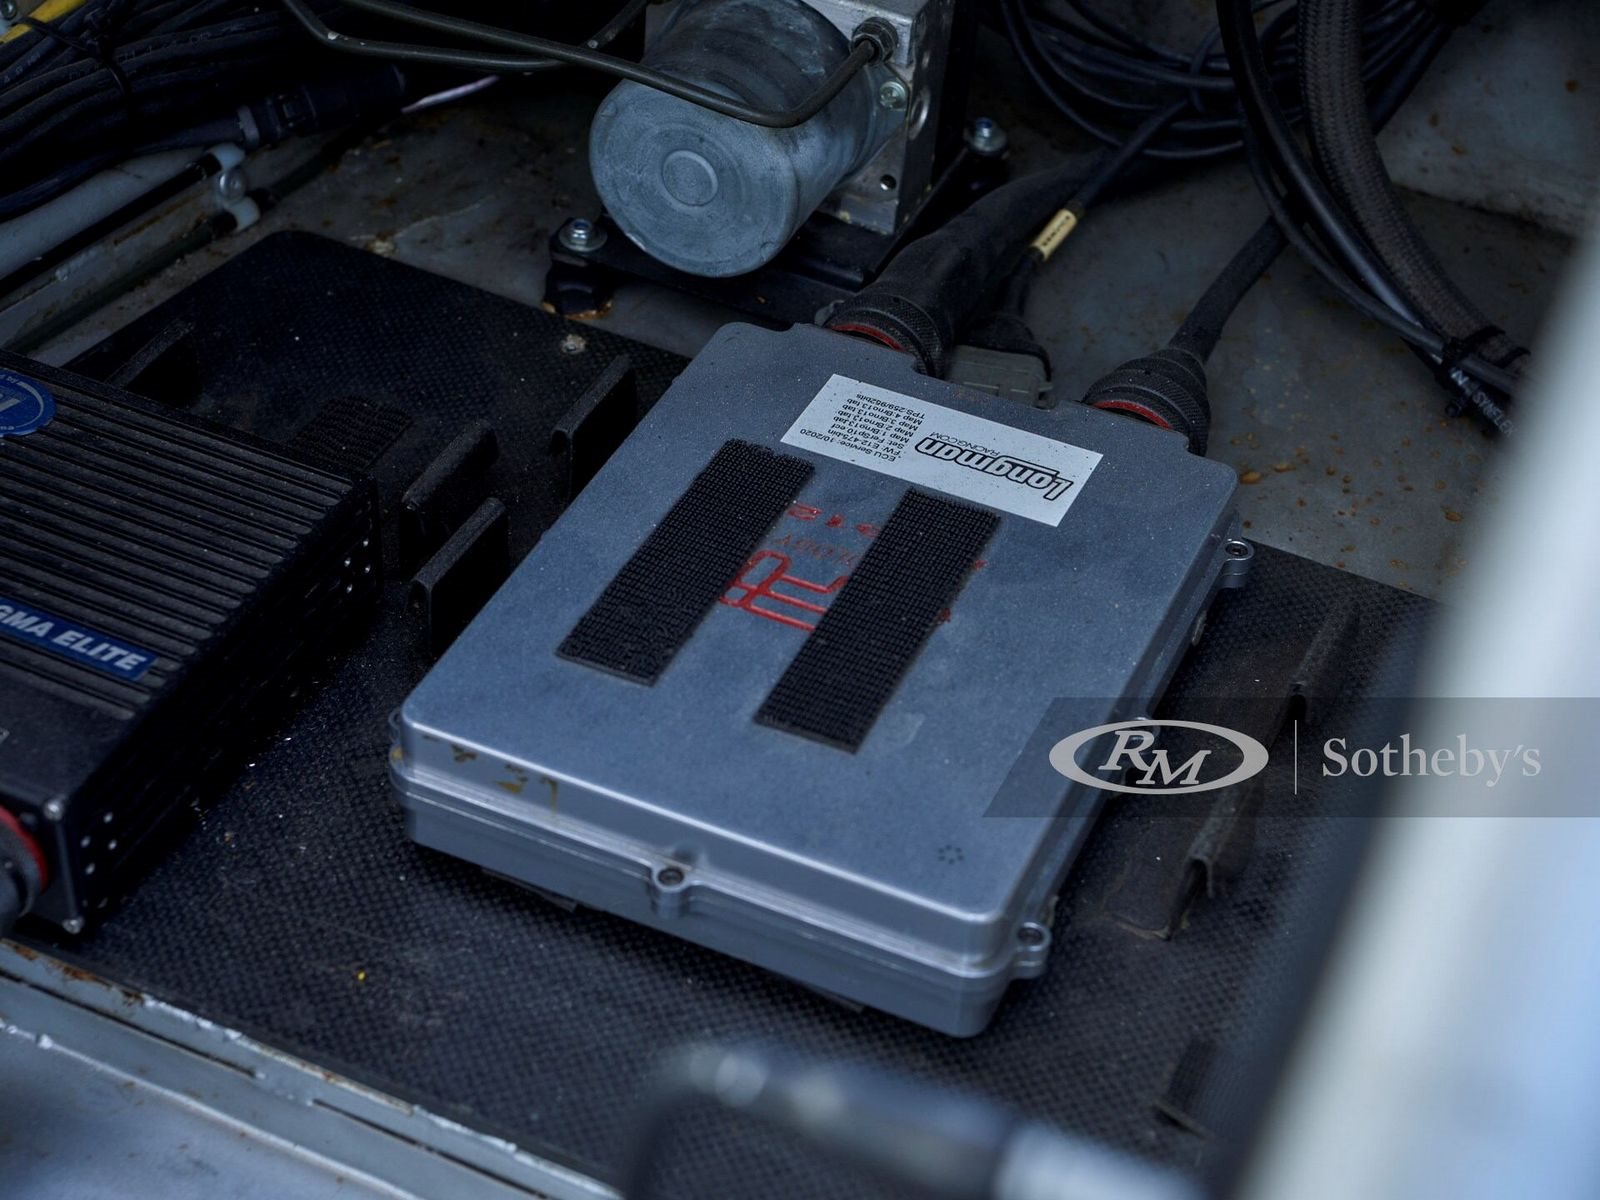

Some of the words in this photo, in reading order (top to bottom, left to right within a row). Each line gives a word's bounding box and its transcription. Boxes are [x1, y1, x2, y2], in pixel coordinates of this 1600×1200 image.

[903, 415, 922, 425] Map
[899, 421, 918, 431] Map
[800, 429, 834, 443] 10/2020
[894, 427, 913, 437] Map
[890, 433, 909, 443] Map
[837, 441, 872, 454] Service:
[887, 441, 904, 449] Set:
[881, 446, 900, 456] FW:
[874, 451, 896, 462] ECU
[915, 436, 1074, 501] Longman
[52, 630, 147, 670] ELITE
